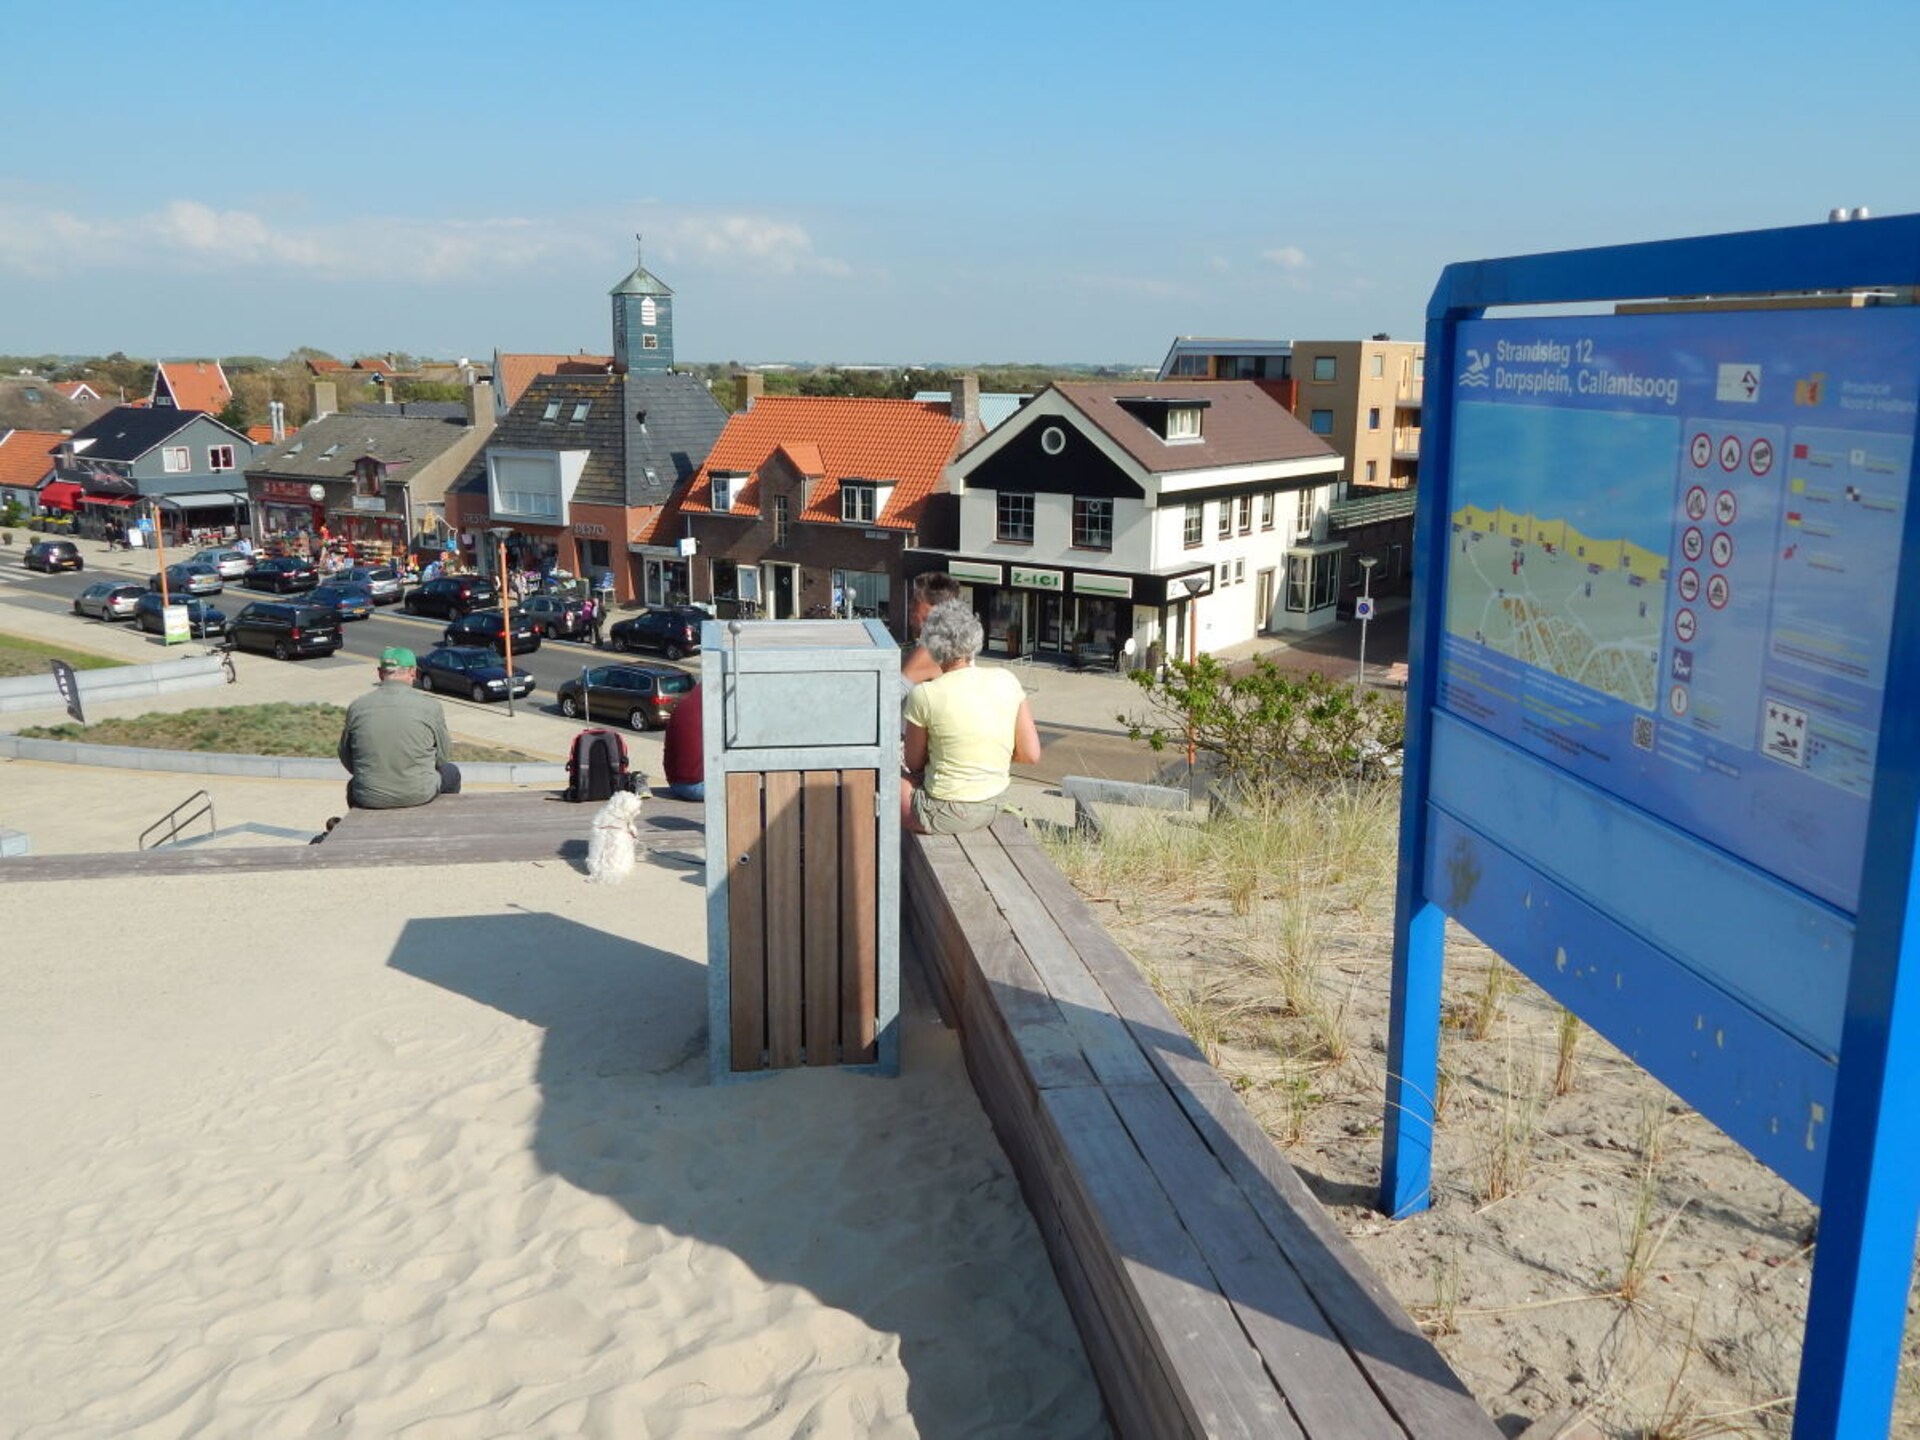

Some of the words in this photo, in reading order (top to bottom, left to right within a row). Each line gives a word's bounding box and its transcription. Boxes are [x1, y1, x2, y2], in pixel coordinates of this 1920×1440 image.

[1496, 339, 1570, 368] Strandslag
[1575, 339, 1593, 363] 12
[1495, 367, 1573, 396] Dorpsplein,
[1577, 369, 1679, 405] Callantsoog
